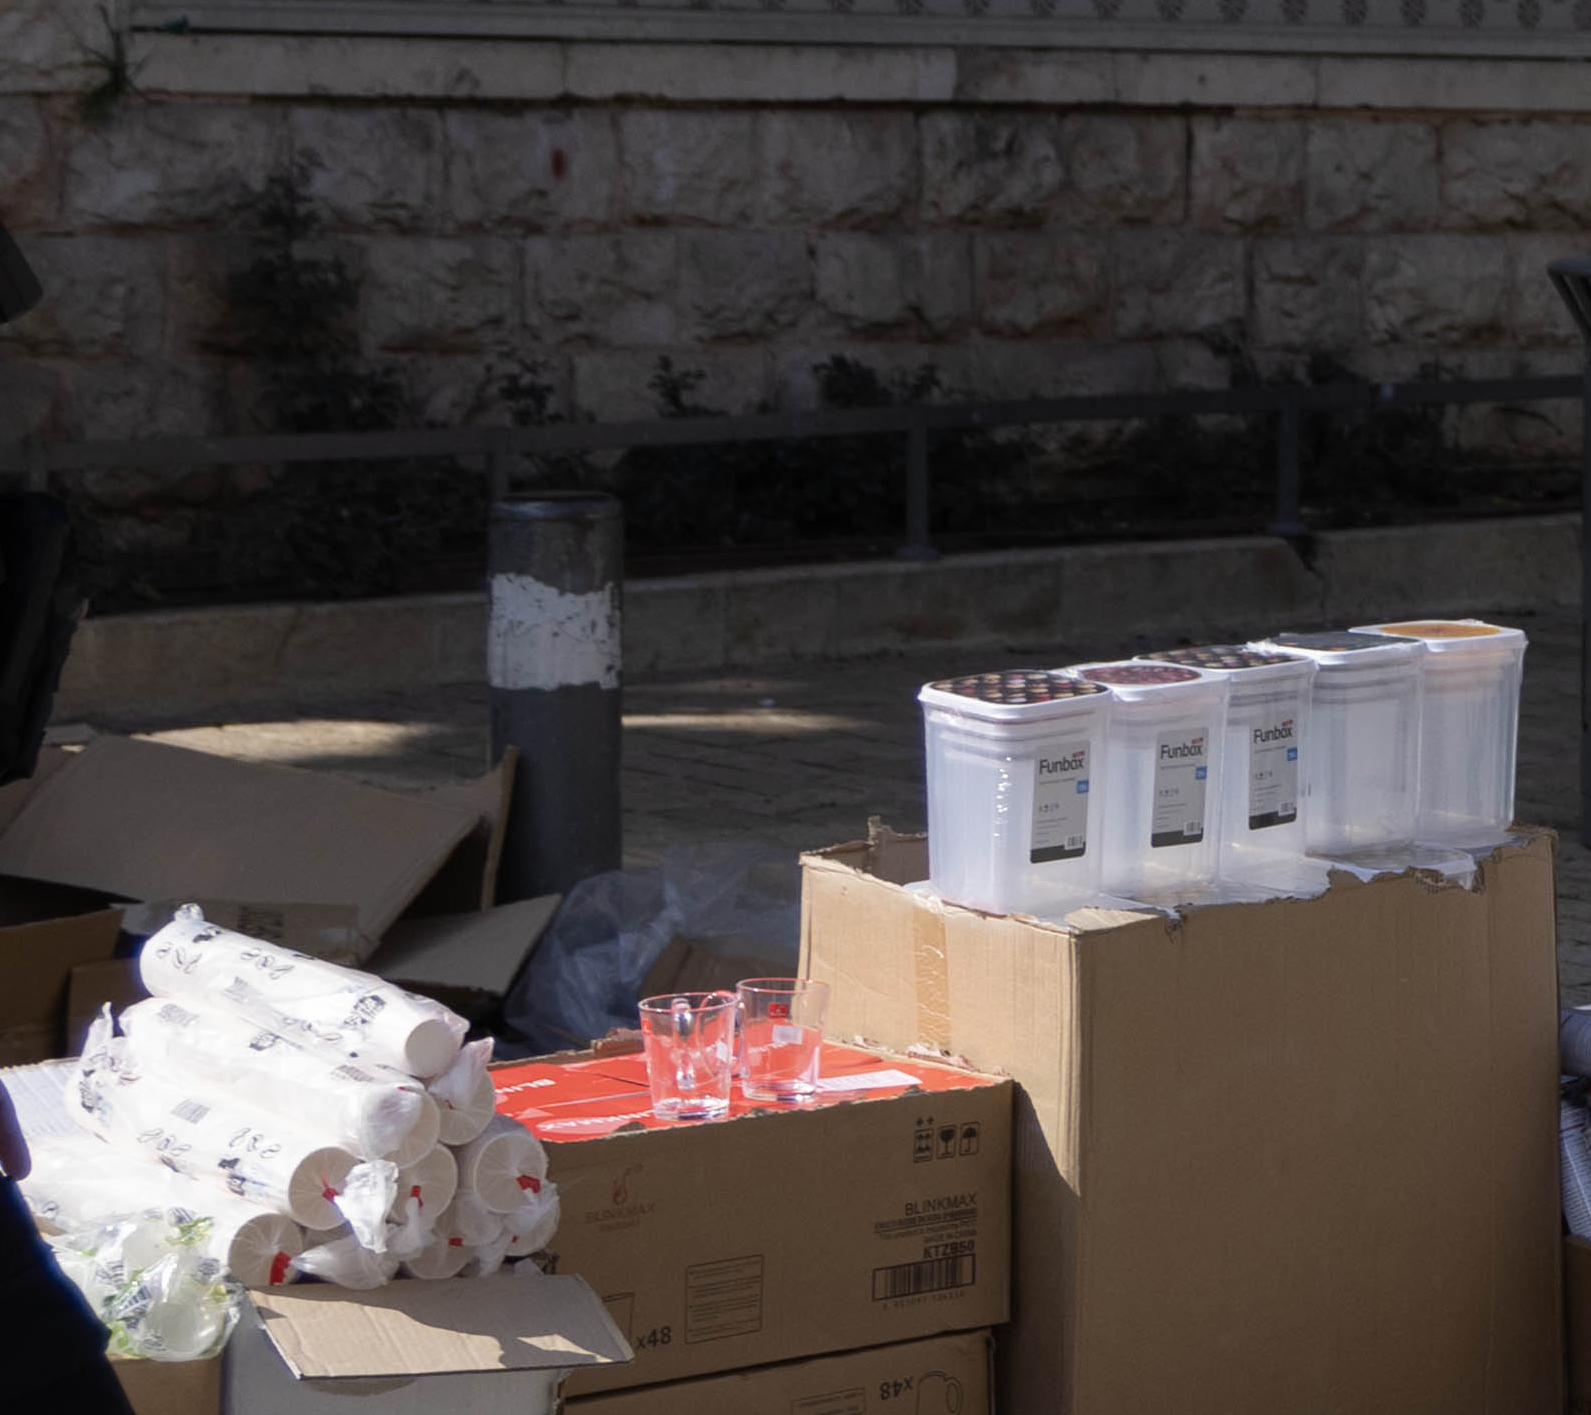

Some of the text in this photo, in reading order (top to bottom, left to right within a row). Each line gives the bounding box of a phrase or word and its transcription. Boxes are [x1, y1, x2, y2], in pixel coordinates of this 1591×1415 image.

[1253, 725, 1294, 743] Funbox
[1160, 742, 1204, 761] Funbox
[1038, 756, 1085, 775] Funbox
[904, 1192, 978, 1216] BLINKMAX
[636, 1325, 673, 1351] x48
[879, 1375, 914, 1402] x48
